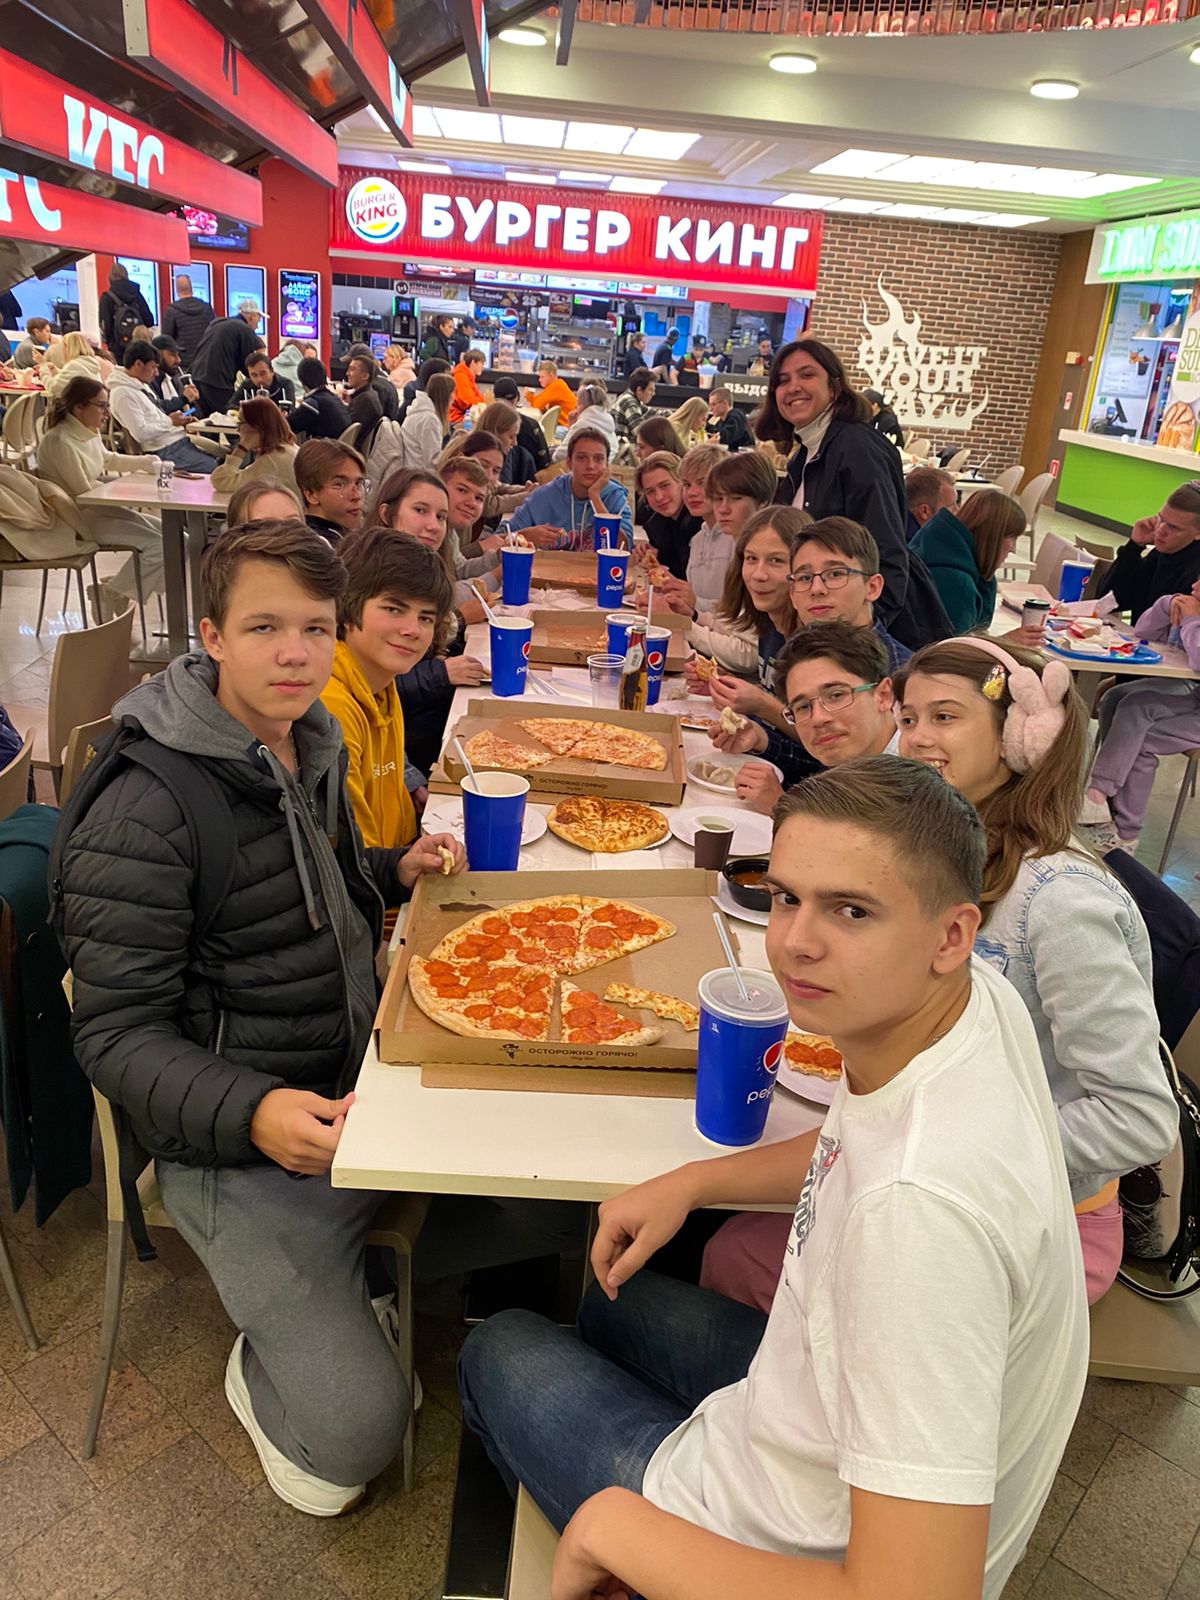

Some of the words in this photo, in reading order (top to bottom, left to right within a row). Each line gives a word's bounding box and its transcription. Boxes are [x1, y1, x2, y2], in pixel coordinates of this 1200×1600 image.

[353, 192, 396, 210] BURGER
[356, 203, 398, 225] KING
[421, 193, 631, 254] БУРГЕР
[655, 215, 809, 271] КИНГ
[481, 306, 506, 317] PEPSI
[857, 344, 949, 369] HAVE
[953, 346, 987, 369] IT
[864, 364, 974, 393] YOUR
[539, 778, 581, 787] ОСТОРОЖНО
[528, 1047, 594, 1056] ОСТОРОЖНО
[595, 1050, 638, 1058] ГОРЯЧО!
